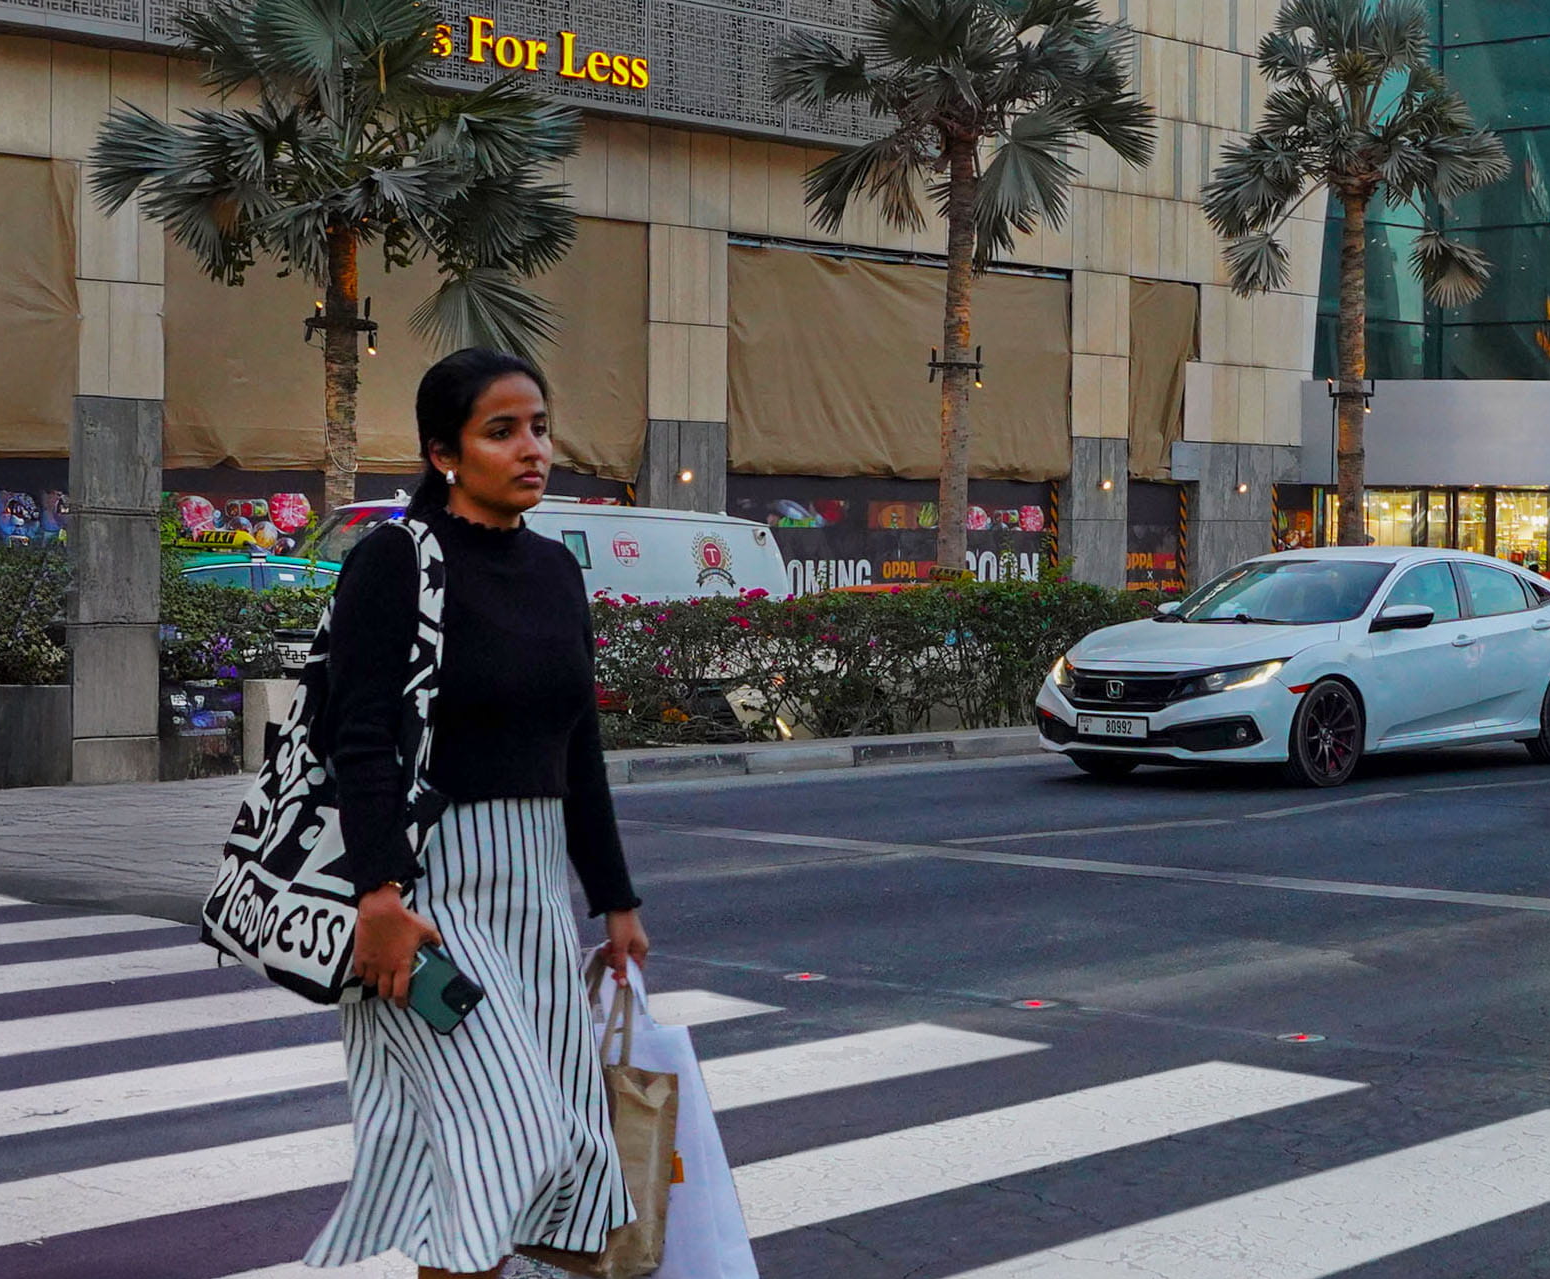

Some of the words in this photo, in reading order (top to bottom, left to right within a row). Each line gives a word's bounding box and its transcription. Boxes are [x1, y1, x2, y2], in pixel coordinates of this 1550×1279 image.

[468, 15, 548, 70] For
[559, 31, 650, 90] Less
[202, 530, 232, 543] TAXI
[787, 559, 872, 599] OMING
[882, 561, 917, 579] OPPA
[1105, 719, 1133, 734] 80992
